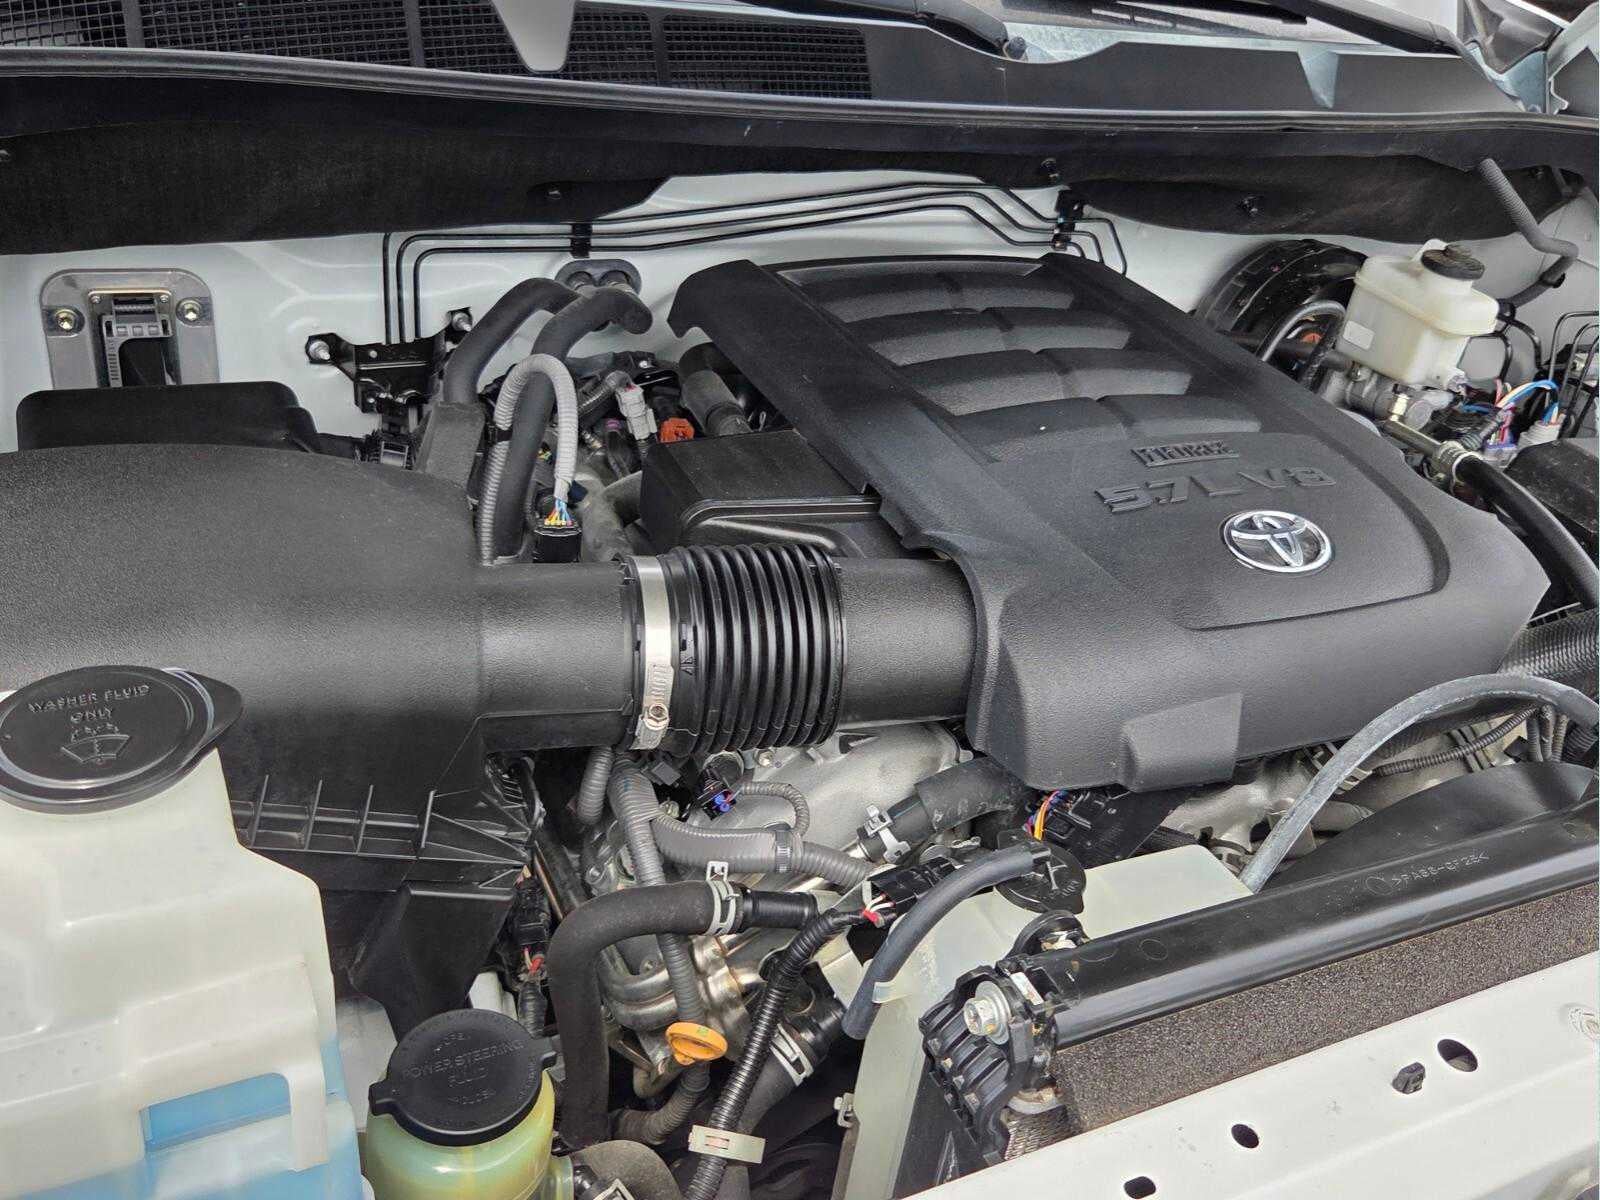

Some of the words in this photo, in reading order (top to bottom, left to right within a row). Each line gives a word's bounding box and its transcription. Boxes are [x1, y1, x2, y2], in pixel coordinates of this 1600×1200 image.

[104, 683, 151, 701] FLUID
[70, 706, 113, 723] ONLY
[402, 1057, 452, 1080] POWER
[454, 1039, 526, 1067] STEERING
